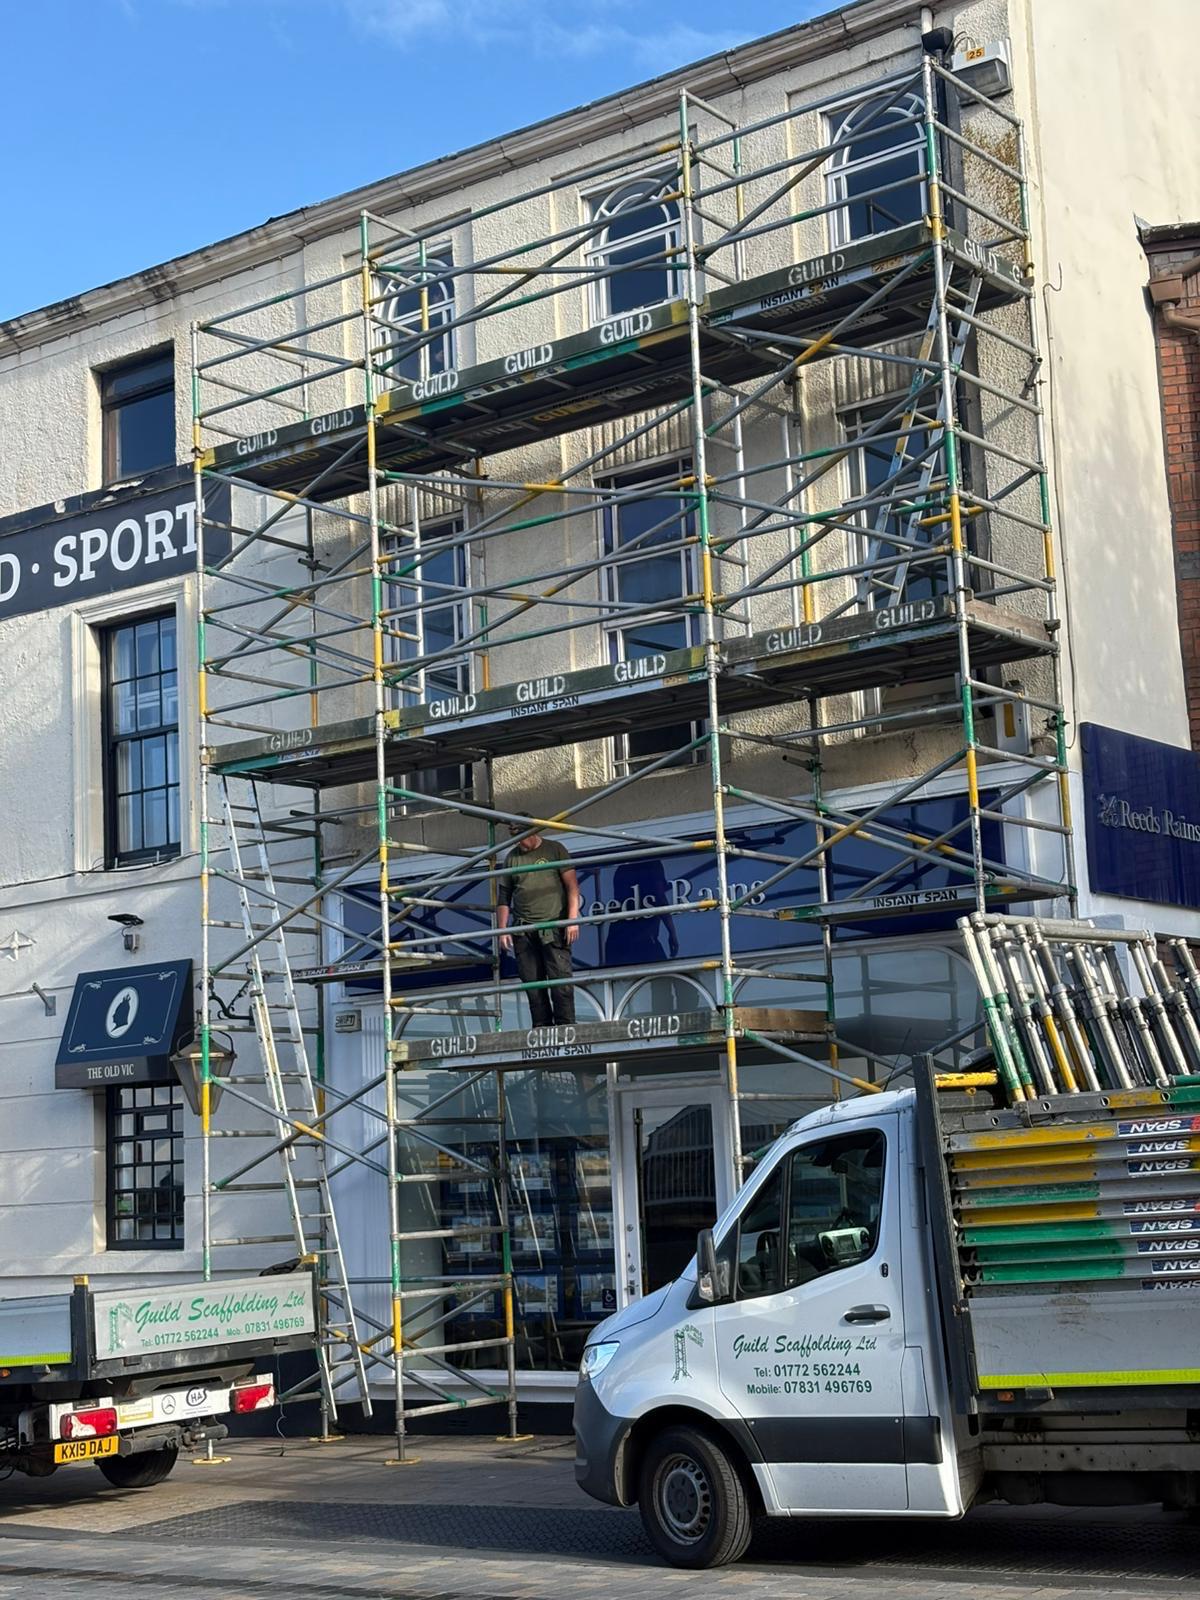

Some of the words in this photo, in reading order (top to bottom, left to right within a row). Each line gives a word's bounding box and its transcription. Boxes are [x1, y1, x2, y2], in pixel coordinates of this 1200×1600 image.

[969, 50, 982, 60] 25
[788, 253, 846, 286] GUILD
[760, 286, 805, 310] INSTANT
[599, 312, 653, 344] GUILD
[504, 343, 553, 375] GUILD
[412, 371, 459, 401] GUILD
[310, 409, 354, 436] GUILD
[236, 429, 278, 456] GUILD
[54, 499, 206, 588] SPORT
[875, 600, 936, 630] GUILD
[766, 624, 822, 652] GUILD
[613, 654, 666, 682] GUILD
[516, 676, 566, 702] GUILD
[429, 694, 477, 718] GUILD
[510, 702, 549, 717] INSTANT
[552, 696, 580, 710] SPAN
[270, 729, 313, 751] GUILD
[1119, 800, 1160, 834] Reeds
[873, 895, 920, 908] INSTANT
[924, 890, 958, 902] SPAN
[526, 1027, 576, 1047] GUILD
[627, 1015, 681, 1038] GUILD
[430, 1035, 477, 1057] GUILD
[521, 1047, 561, 1059] INSTANT
[563, 1044, 592, 1056] SPAN
[87, 1067, 103, 1079] THE
[104, 1065, 120, 1078] OLD
[121, 1064, 135, 1076] VIC
[1130, 1120, 1182, 1133] SPAN
[1138, 1140, 1190, 1152] SPAN
[1139, 1159, 1191, 1171] SPAN
[1135, 1200, 1186, 1211] SPAN
[1141, 1219, 1193, 1231] SPAN
[1149, 1239, 1200, 1251] SPAN
[135, 1300, 182, 1333] Guild
[187, 1295, 279, 1324] Scaffolding
[282, 1290, 306, 1308] Ltd
[154, 1334, 182, 1346] 01772
[185, 1328, 219, 1342] 562244
[245, 1321, 271, 1334] 07831
[273, 1316, 305, 1330] 496769
[733, 1334, 769, 1359] Guild
[774, 1334, 853, 1358] Scaffolding
[855, 1336, 878, 1350] Ltd
[754, 1367, 771, 1377] Tel:
[774, 1364, 810, 1377] 01772
[813, 1363, 860, 1376] 562244
[747, 1384, 781, 1394] Mobile:
[784, 1381, 820, 1393] 07831
[824, 1380, 872, 1393] 496769
[61, 1442, 87, 1459] KX19
[90, 1438, 111, 1455] DAJ
